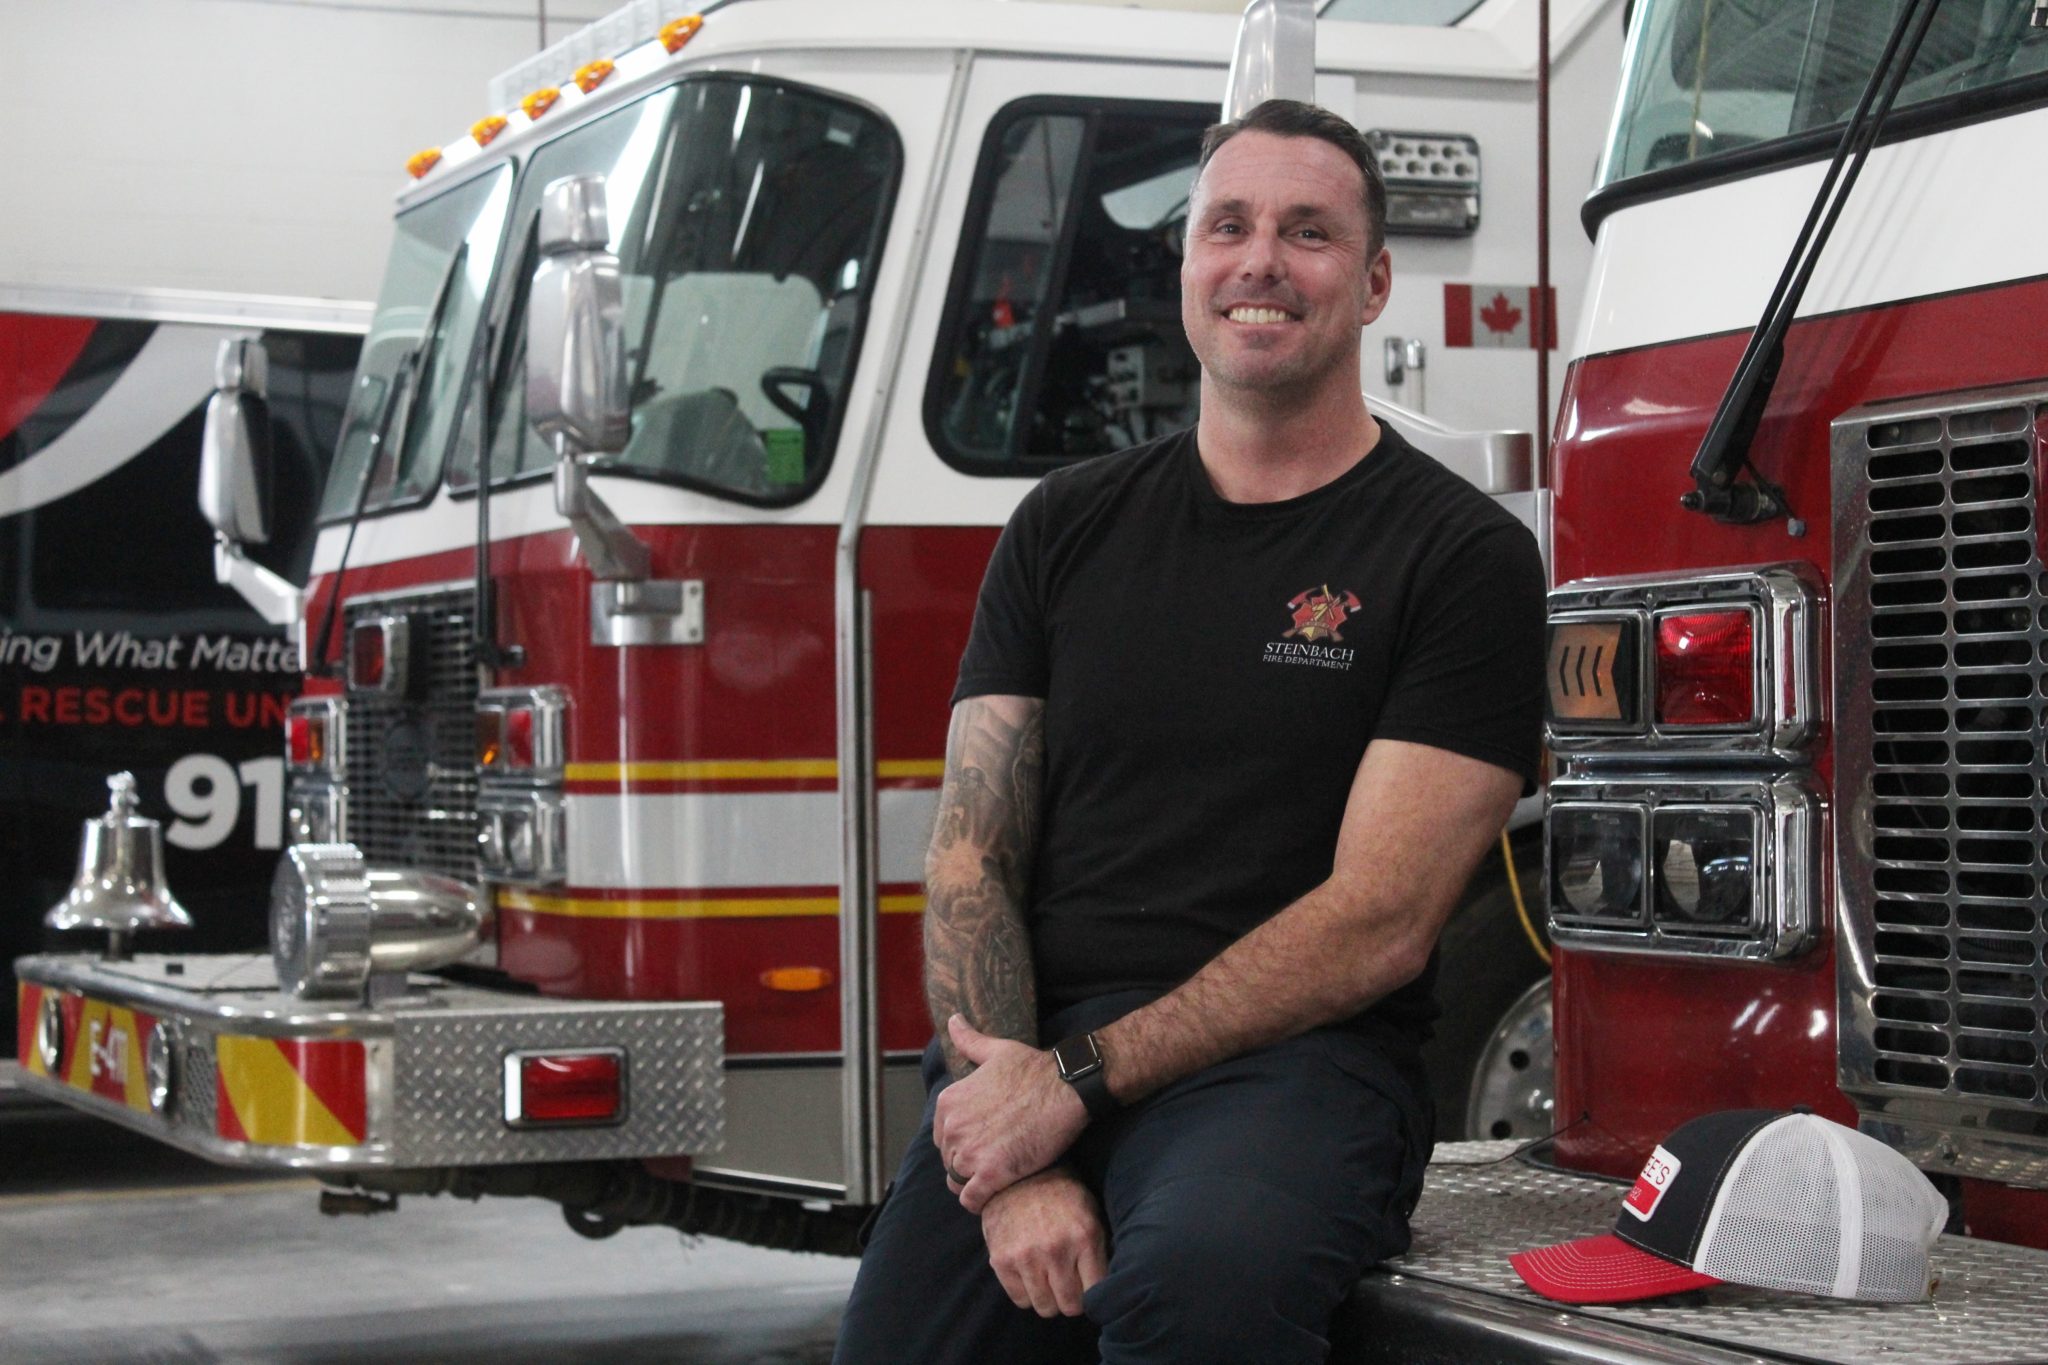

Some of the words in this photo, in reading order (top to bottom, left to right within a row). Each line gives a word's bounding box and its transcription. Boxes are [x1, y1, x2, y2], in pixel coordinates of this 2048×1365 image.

[75, 630, 184, 670] What
[1263, 654, 1283, 663] FIRE
[1285, 656, 1352, 671] DEPARTMENT
[1265, 642, 1354, 661] STEINBACH
[21, 686, 209, 726] RESCUE
